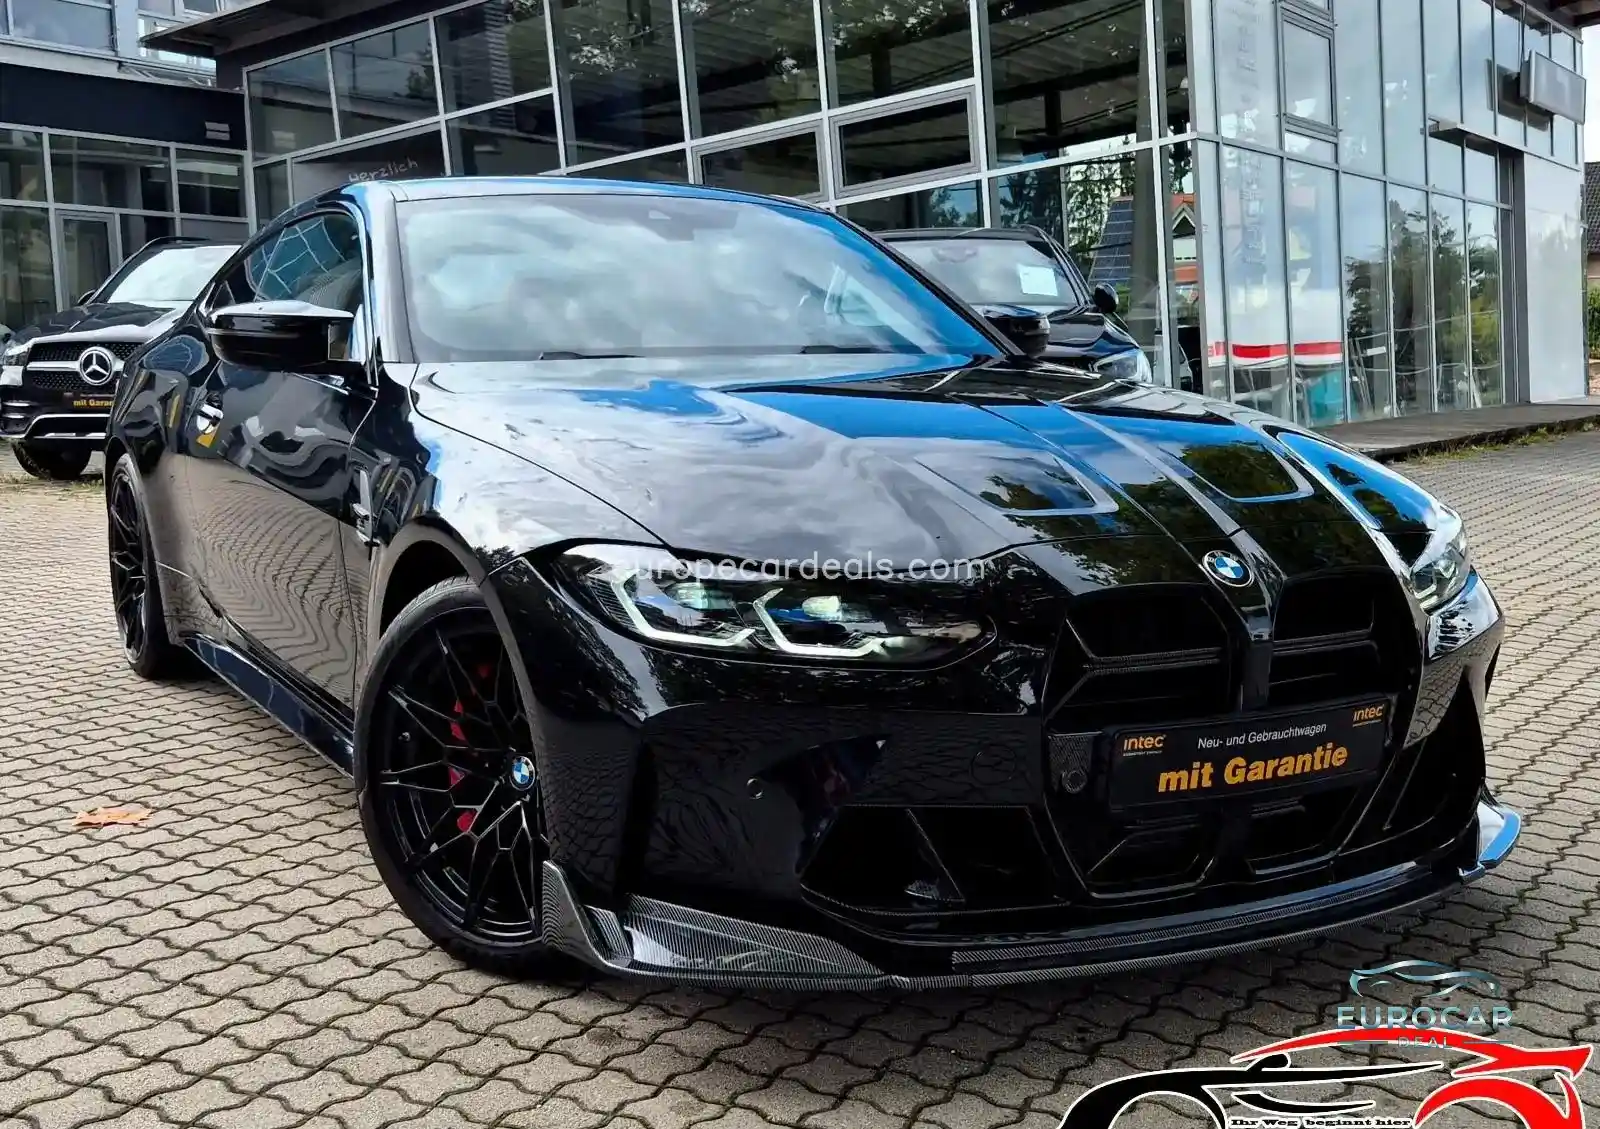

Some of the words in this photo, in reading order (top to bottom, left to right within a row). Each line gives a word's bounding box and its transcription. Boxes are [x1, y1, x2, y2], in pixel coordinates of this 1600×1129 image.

[1351, 704, 1384, 722] intec
[1123, 734, 1166, 752] intec
[1197, 737, 1223, 749] Neu-
[1225, 733, 1246, 746] und
[1247, 723, 1328, 744] Gebrauchtwagen
[1158, 761, 1214, 793] mit
[1224, 742, 1349, 785] Garantie
